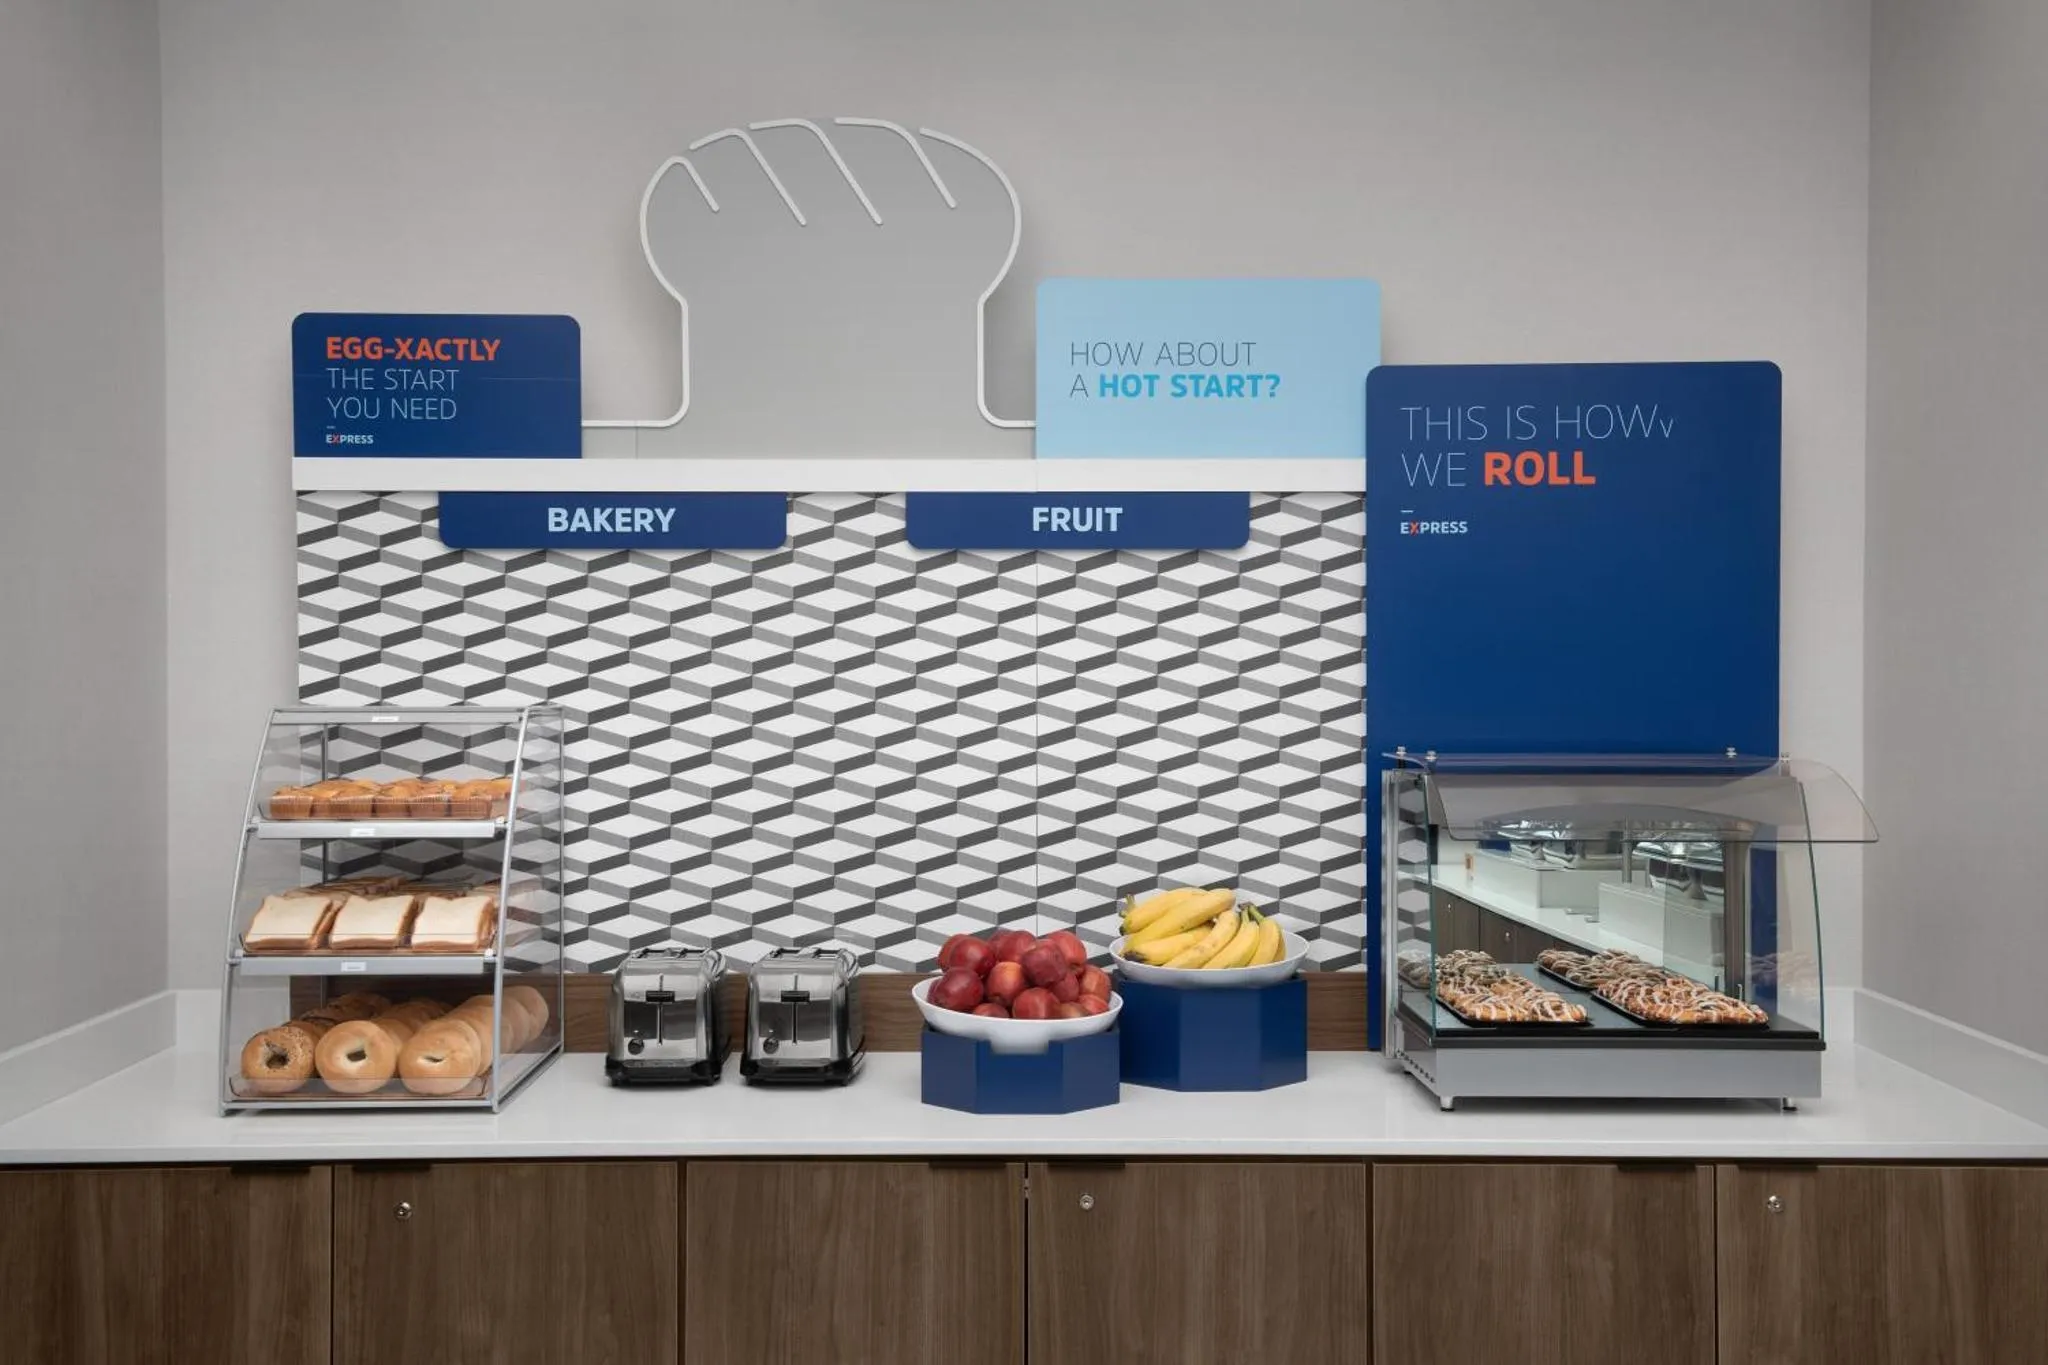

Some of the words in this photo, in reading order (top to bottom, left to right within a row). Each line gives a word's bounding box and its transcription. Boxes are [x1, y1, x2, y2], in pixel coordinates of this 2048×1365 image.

[326, 336, 501, 362] EGG-XACTLY
[1071, 341, 1144, 367] HOW
[1155, 341, 1257, 367] ABOUT
[326, 367, 375, 390] THE
[384, 368, 460, 391] START
[1069, 373, 1089, 398] A
[1099, 374, 1160, 398] HOT
[1170, 374, 1281, 398] START?
[326, 396, 380, 420] YOU
[391, 397, 457, 420] NEED
[1400, 405, 1488, 441] THIS
[1506, 405, 1537, 441] IS
[326, 434, 374, 445] EXPRESS
[1401, 452, 1466, 487] WE
[1484, 450, 1597, 487] ROLL
[547, 507, 677, 533] BAKERY
[1032, 506, 1124, 532] FRUIT
[1400, 521, 1468, 535] EXPRESS
